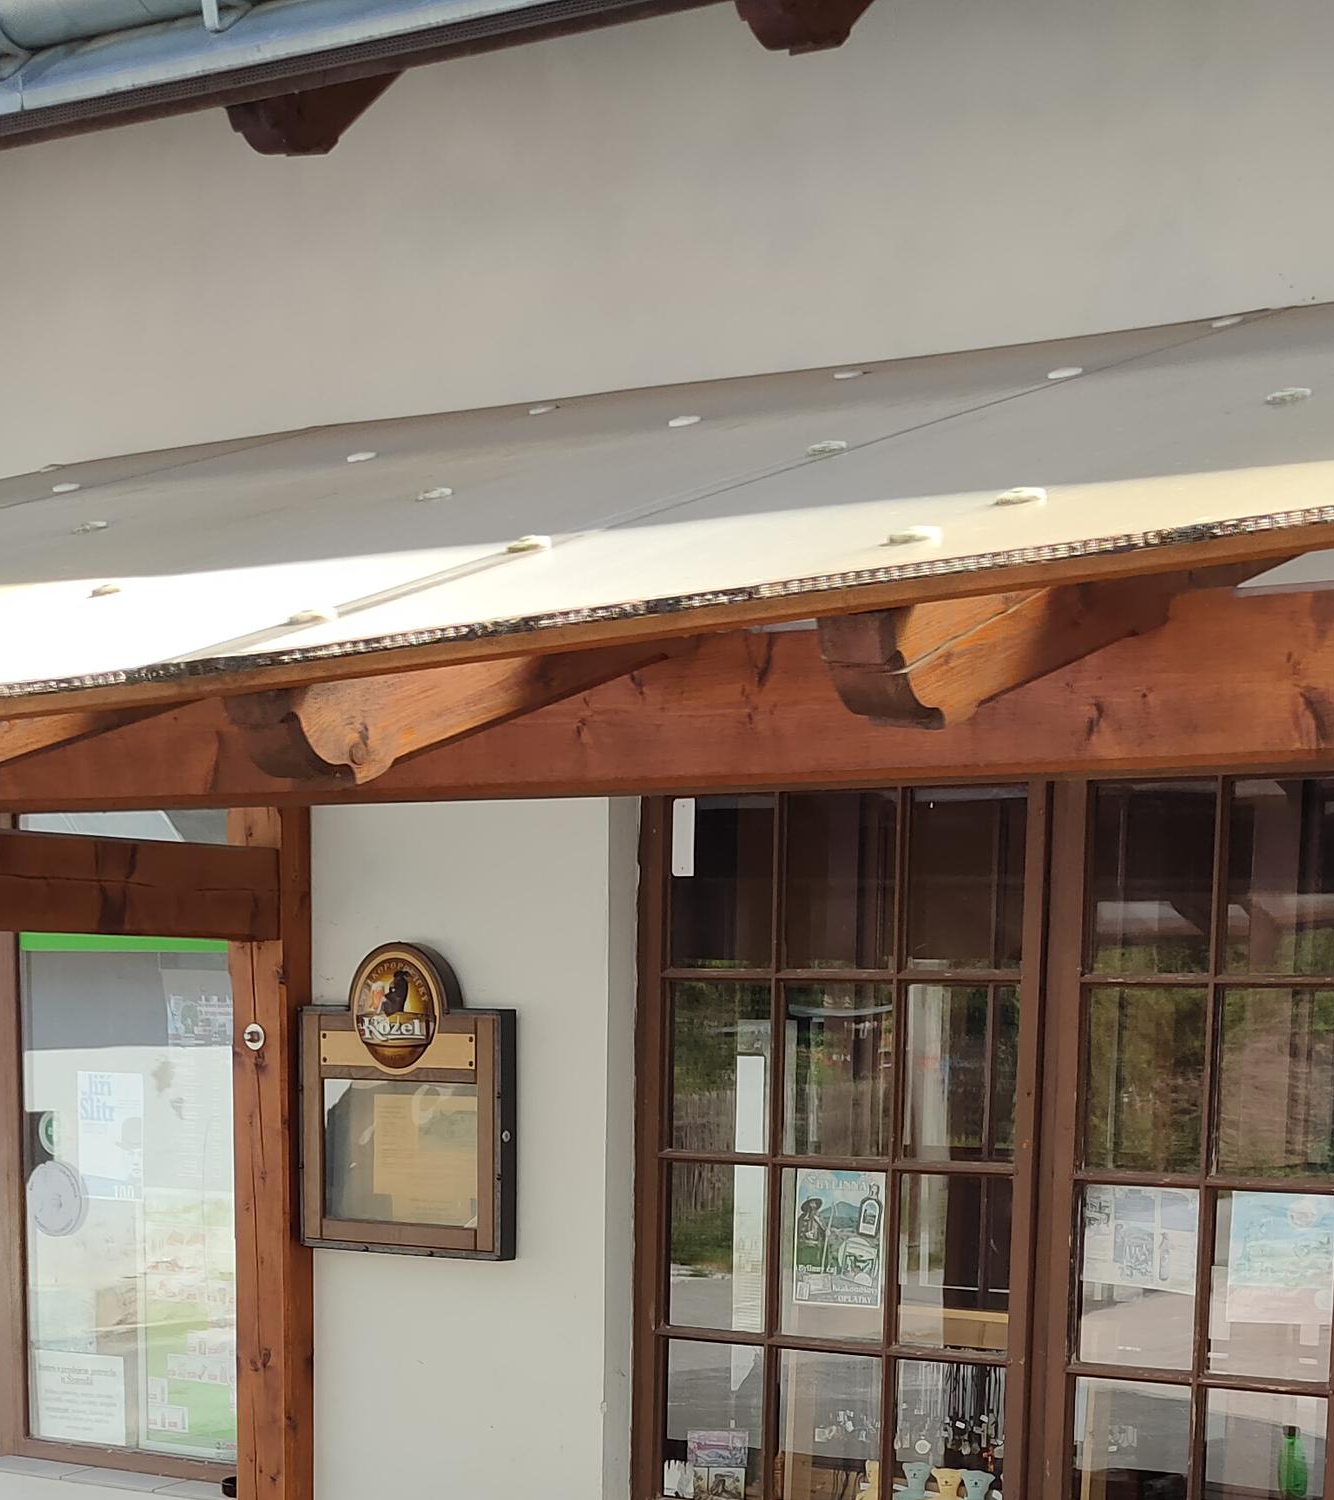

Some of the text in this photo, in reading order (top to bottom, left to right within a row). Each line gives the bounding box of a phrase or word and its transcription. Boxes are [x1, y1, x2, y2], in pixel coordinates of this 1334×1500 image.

[359, 1016, 426, 1041] Kozel
[85, 1073, 112, 1097] Jiří
[80, 1091, 115, 1122] Šlitr
[113, 1185, 135, 1200] 100
